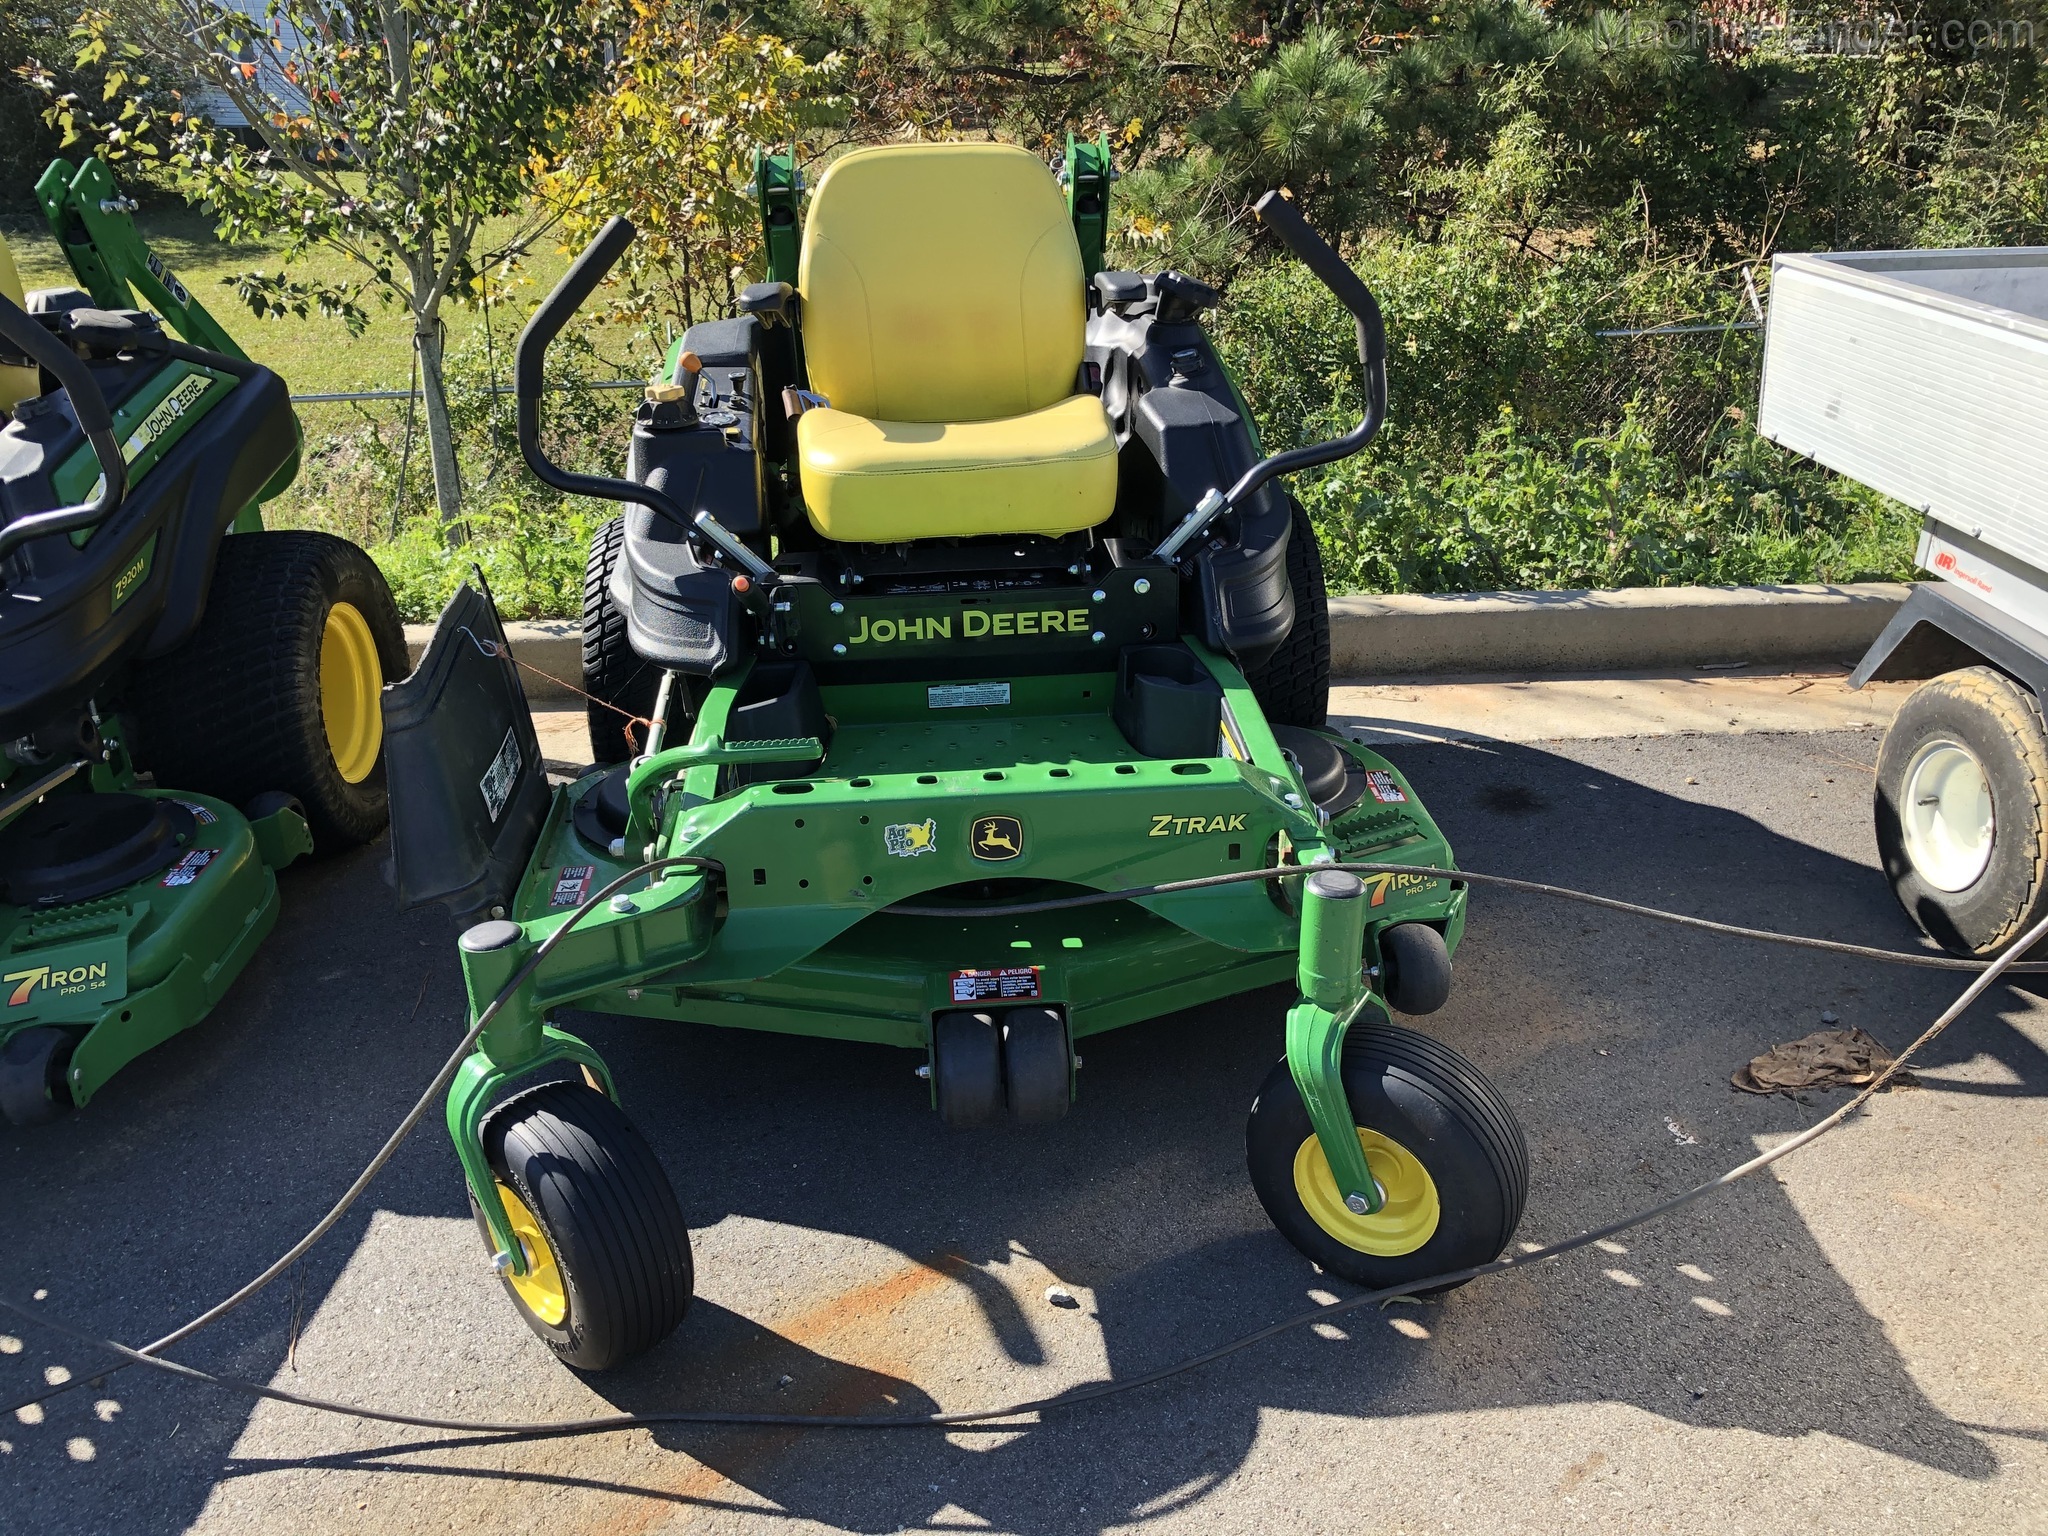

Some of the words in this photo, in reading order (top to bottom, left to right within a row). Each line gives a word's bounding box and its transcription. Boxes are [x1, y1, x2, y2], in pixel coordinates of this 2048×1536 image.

[146, 406, 173, 442] JOHN
[170, 378, 203, 415] DEERE
[115, 558, 145, 600] Z920M
[849, 616, 951, 644] JOHN
[962, 608, 1089, 638] DEERE
[1148, 813, 1249, 838] ZTRAK
[1405, 884, 1424, 897] PRO
[1426, 880, 1438, 890] 54
[60, 984, 86, 996] PRO
[90, 980, 107, 990] 54
